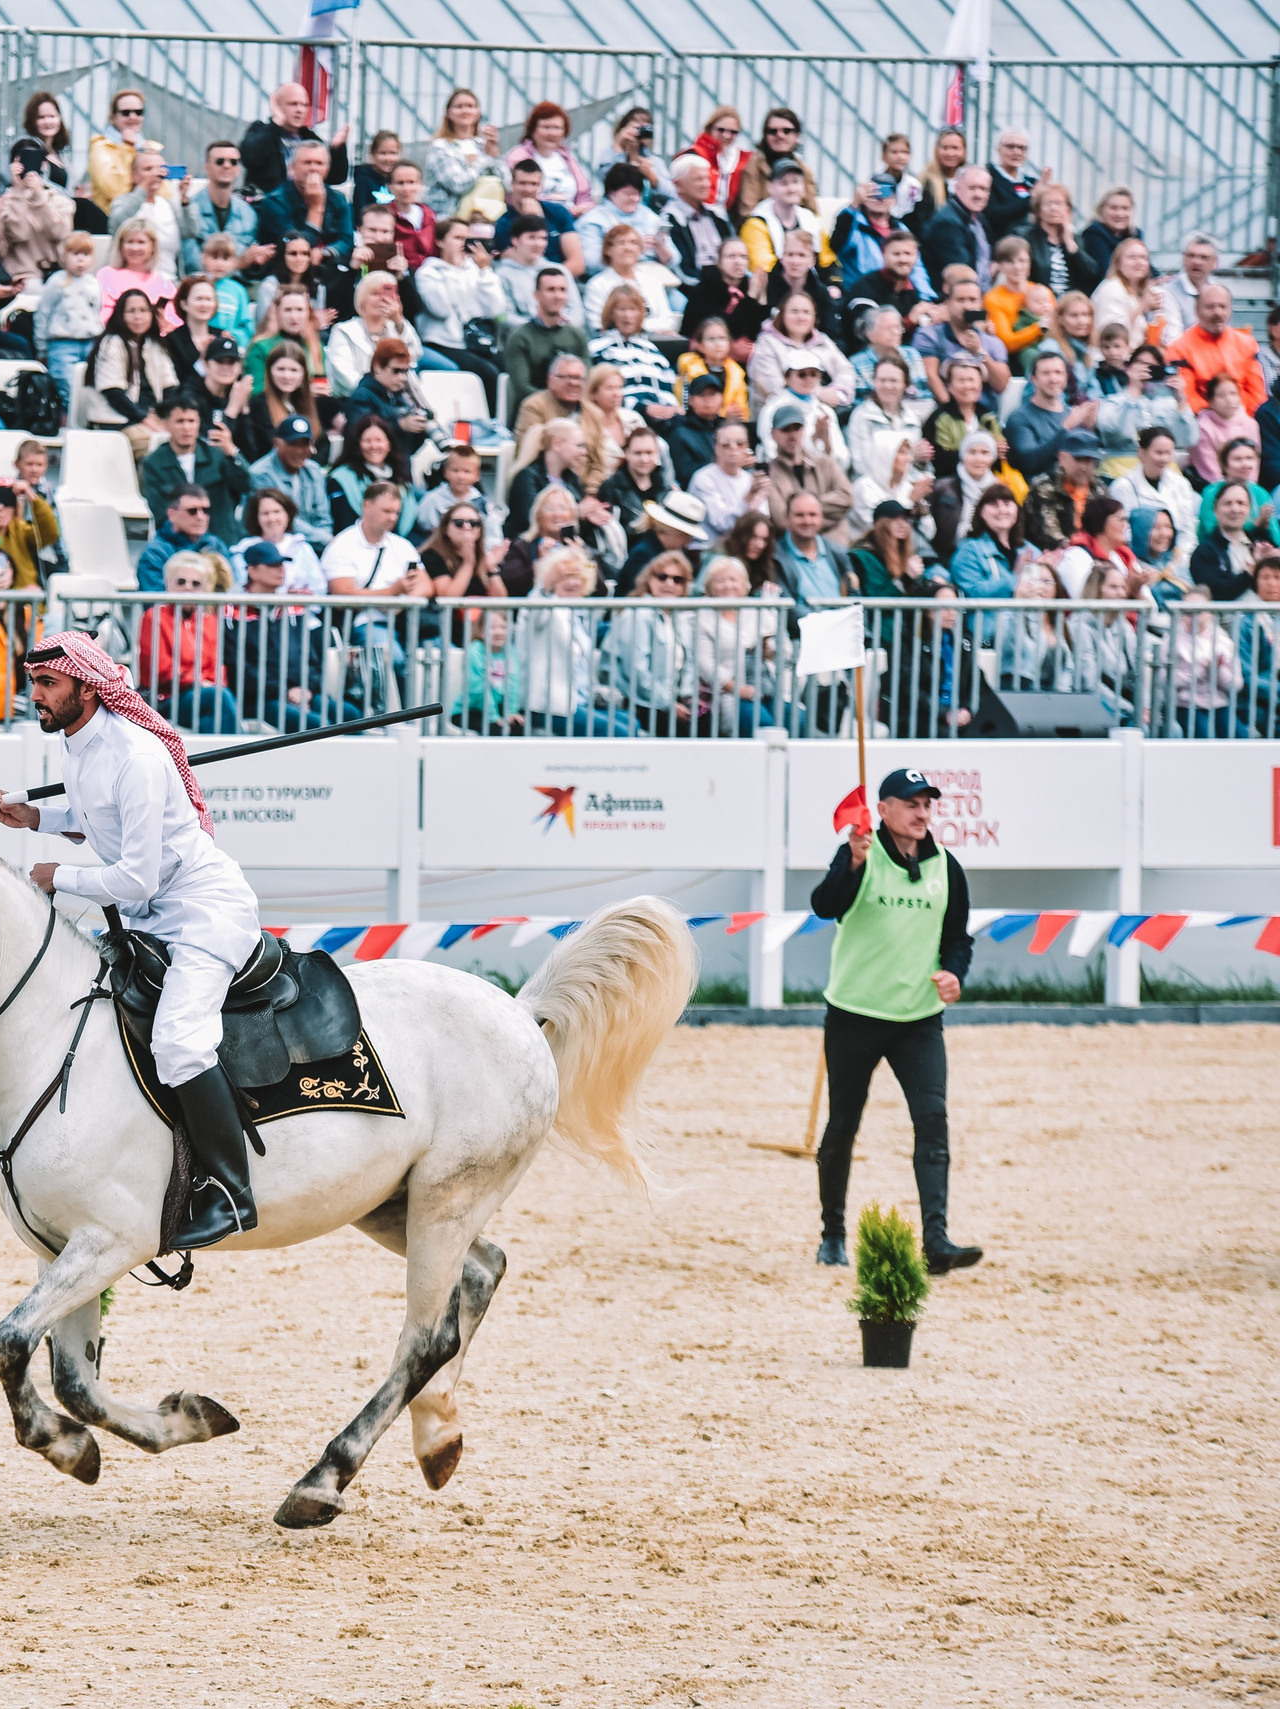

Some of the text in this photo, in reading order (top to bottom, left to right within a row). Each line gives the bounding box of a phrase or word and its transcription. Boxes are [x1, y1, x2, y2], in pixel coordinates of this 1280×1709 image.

[241, 786, 265, 801] ПО
[267, 786, 333, 801] ТУРИЗМУ
[585, 792, 665, 817] Афиша
[931, 794, 983, 817] ЕТО
[232, 809, 296, 823] МОСКВЫ
[877, 895, 933, 911] KIPSTA
